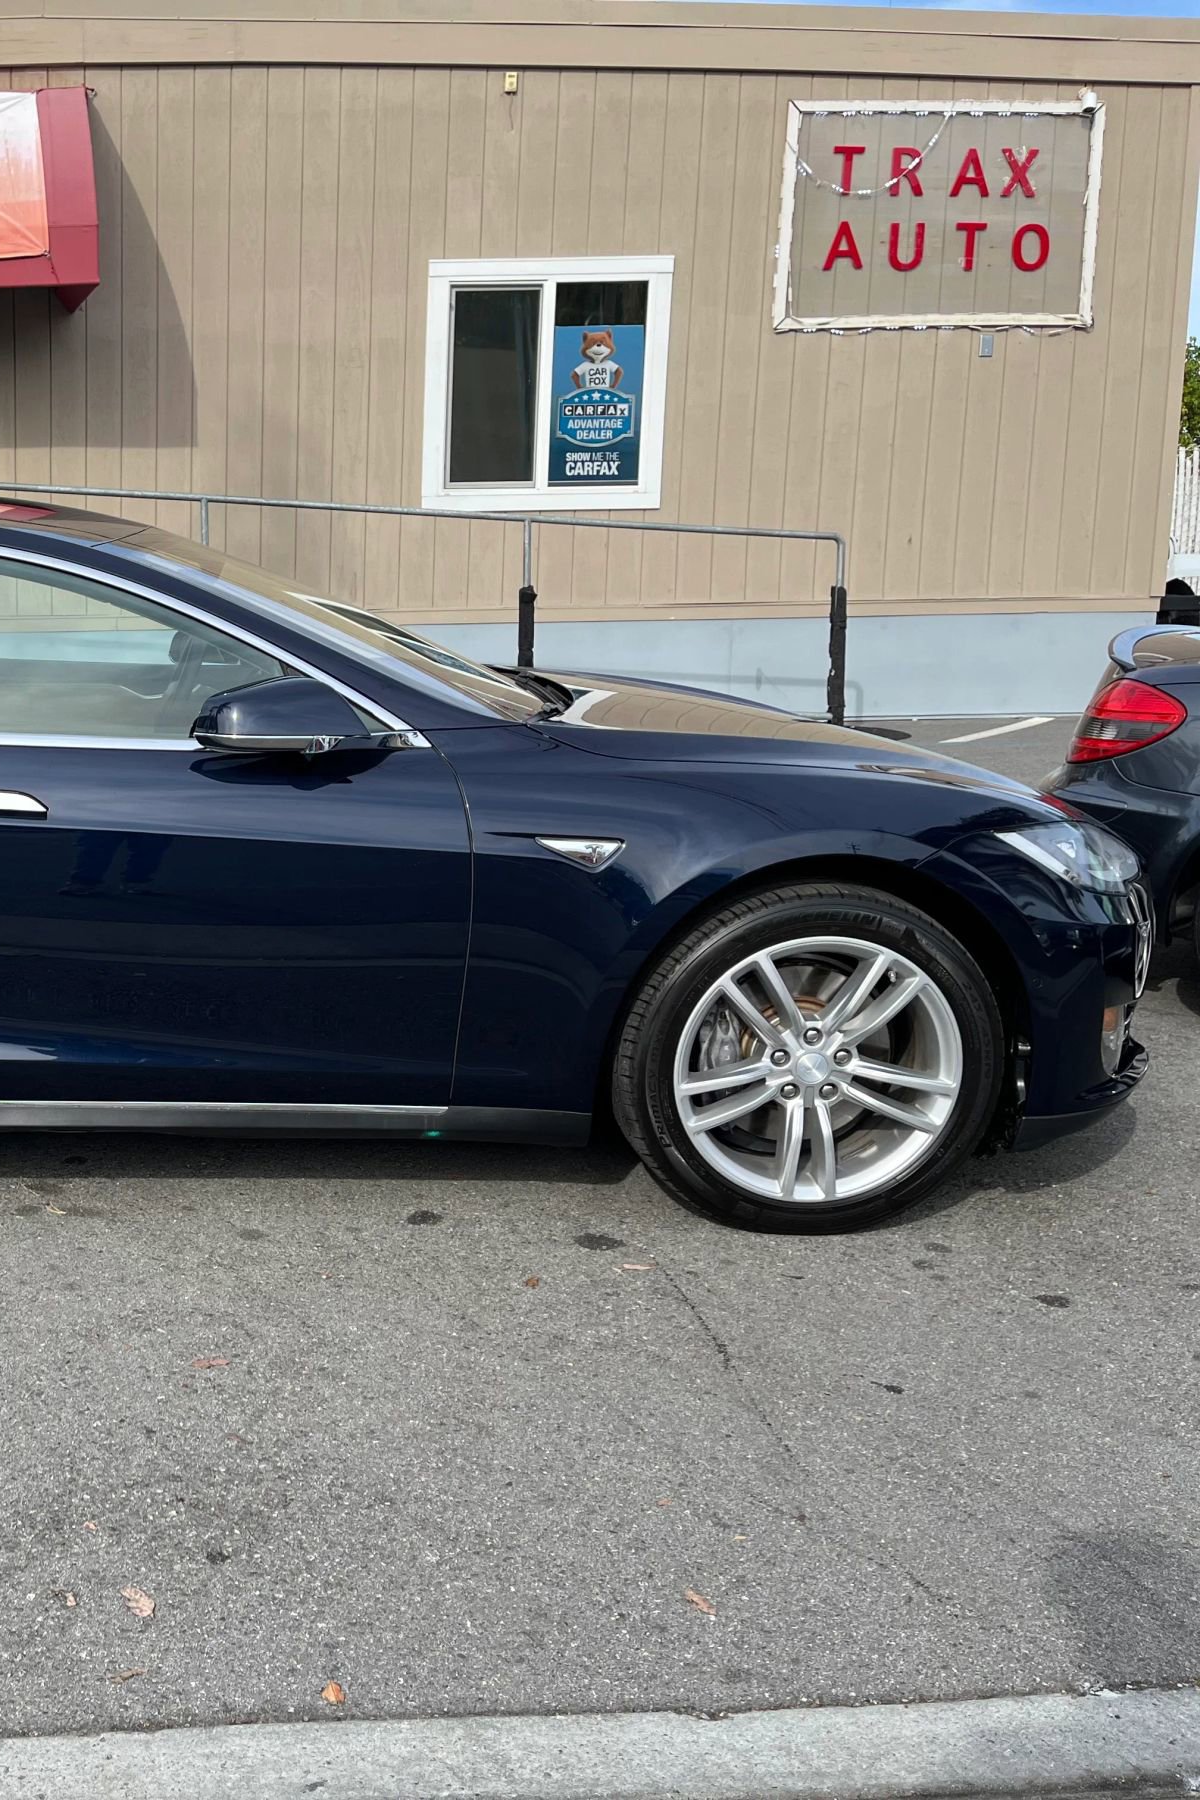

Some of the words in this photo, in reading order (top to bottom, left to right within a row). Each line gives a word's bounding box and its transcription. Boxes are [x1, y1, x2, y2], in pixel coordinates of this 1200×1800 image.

[833, 146, 1040, 197] TRAX
[822, 221, 1051, 272] AUTO
[588, 367, 608, 377] CAR
[588, 377, 607, 385] FOX
[564, 404, 628, 416] CARFAX
[567, 418, 623, 429] ADVANTAGE
[576, 429, 613, 440] DEALER
[566, 452, 591, 462] SHOW
[592, 452, 604, 461] ME
[605, 451, 620, 461] THE
[565, 461, 620, 476] CARFAX
